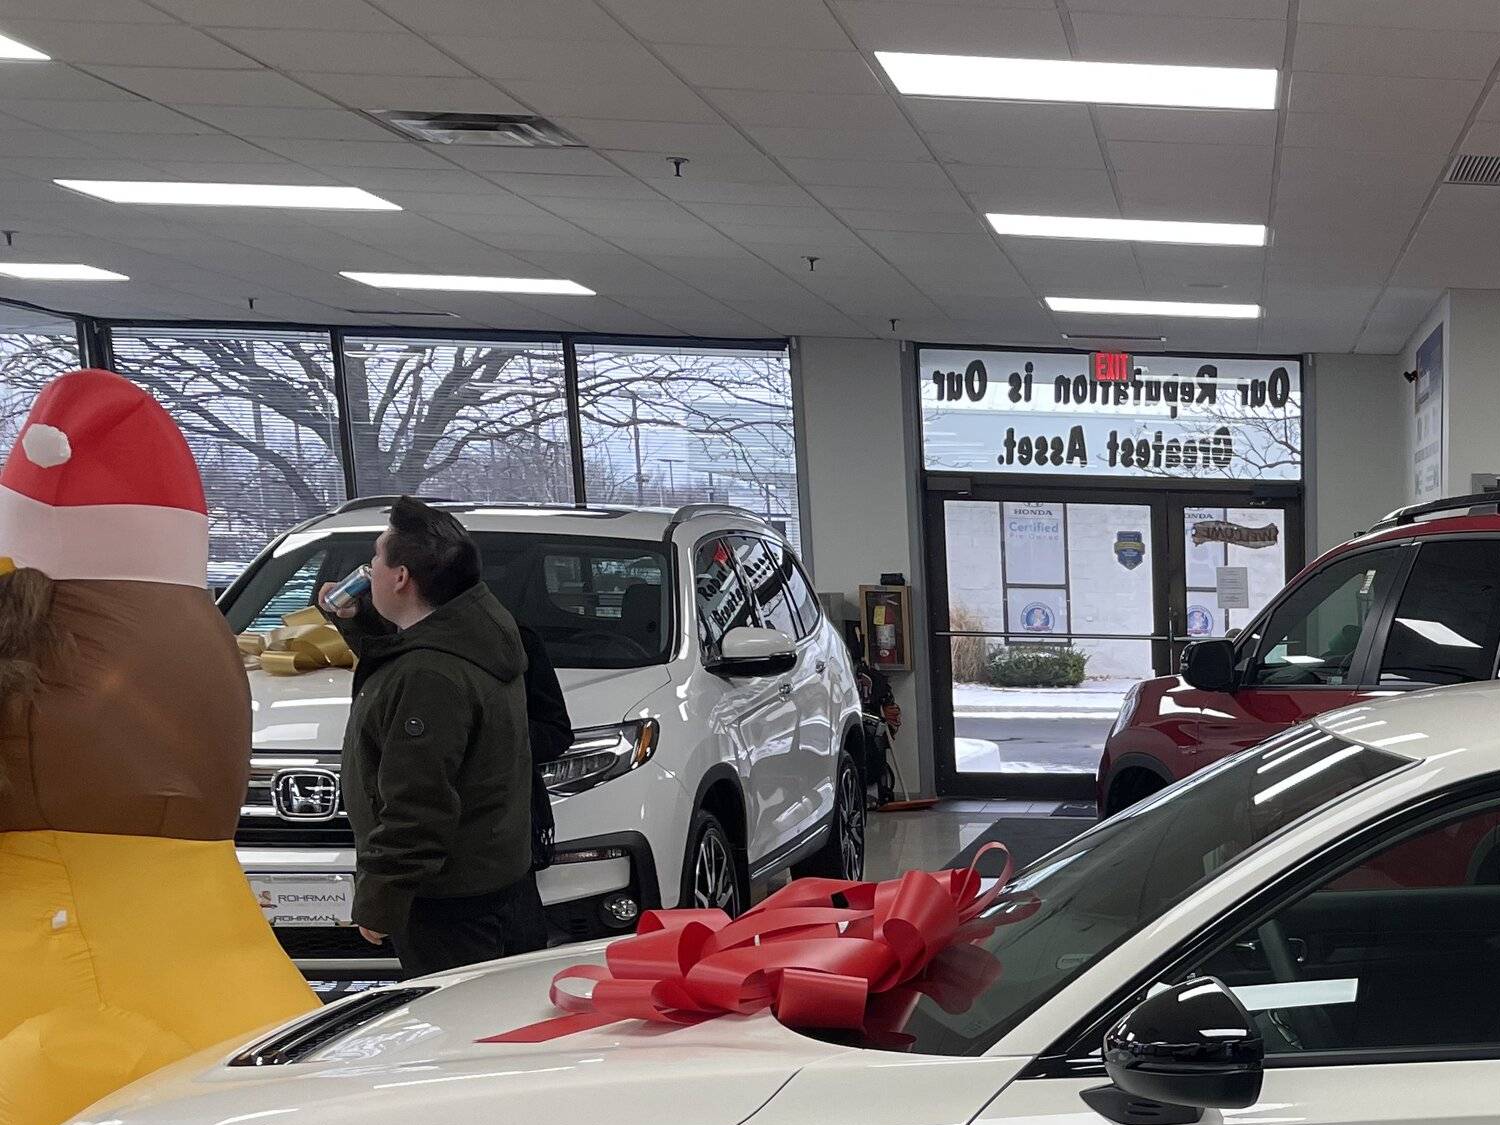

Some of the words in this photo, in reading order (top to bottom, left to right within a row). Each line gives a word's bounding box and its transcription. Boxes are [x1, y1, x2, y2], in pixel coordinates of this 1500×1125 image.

[1095, 352, 1128, 381] EXIT
[1013, 508, 1053, 516] HONDA
[1008, 521, 1059, 533] Certified
[277, 893, 346, 903] ROHRMAN
